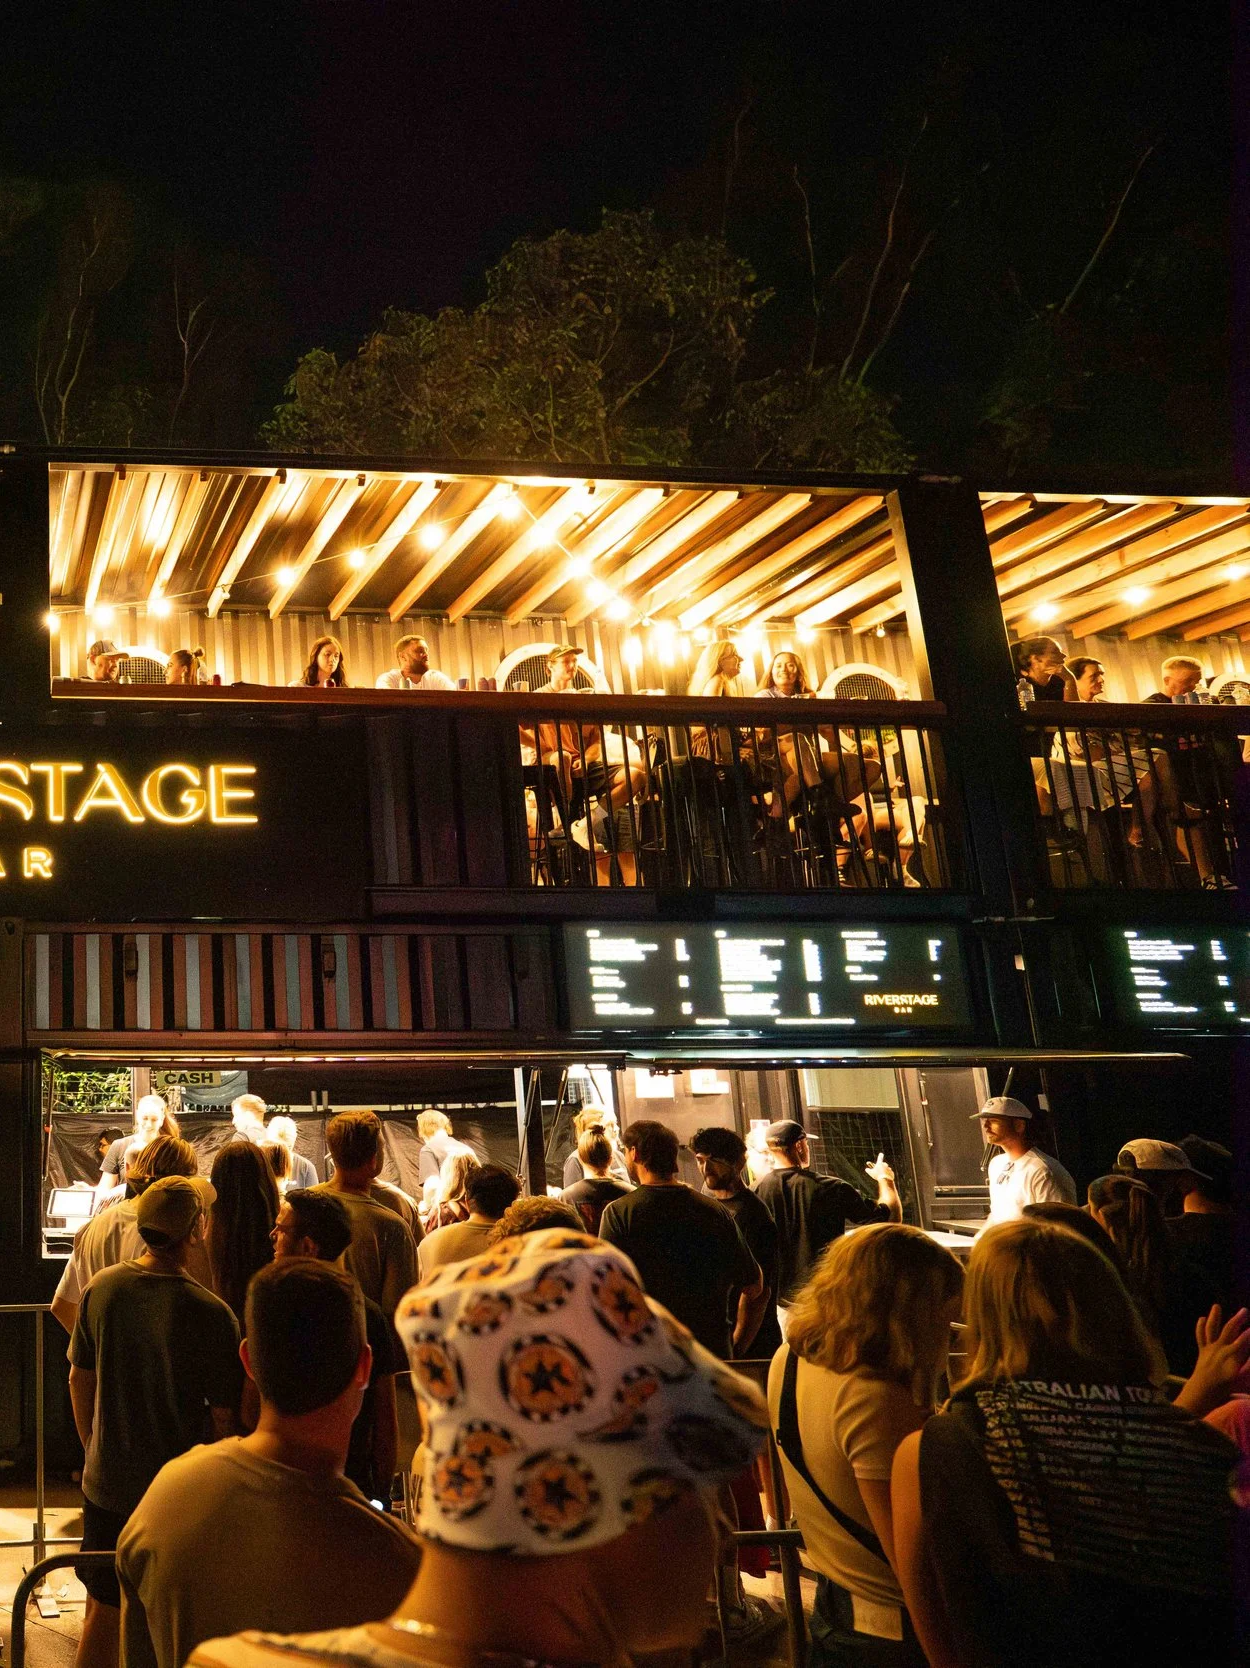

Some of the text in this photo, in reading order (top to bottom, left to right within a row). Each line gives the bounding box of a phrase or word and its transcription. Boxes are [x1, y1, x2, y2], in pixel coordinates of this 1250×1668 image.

[864, 994, 939, 1006] RIVERSTAGE
[893, 1006, 913, 1014] BAR
[163, 1072, 214, 1085] CASH
